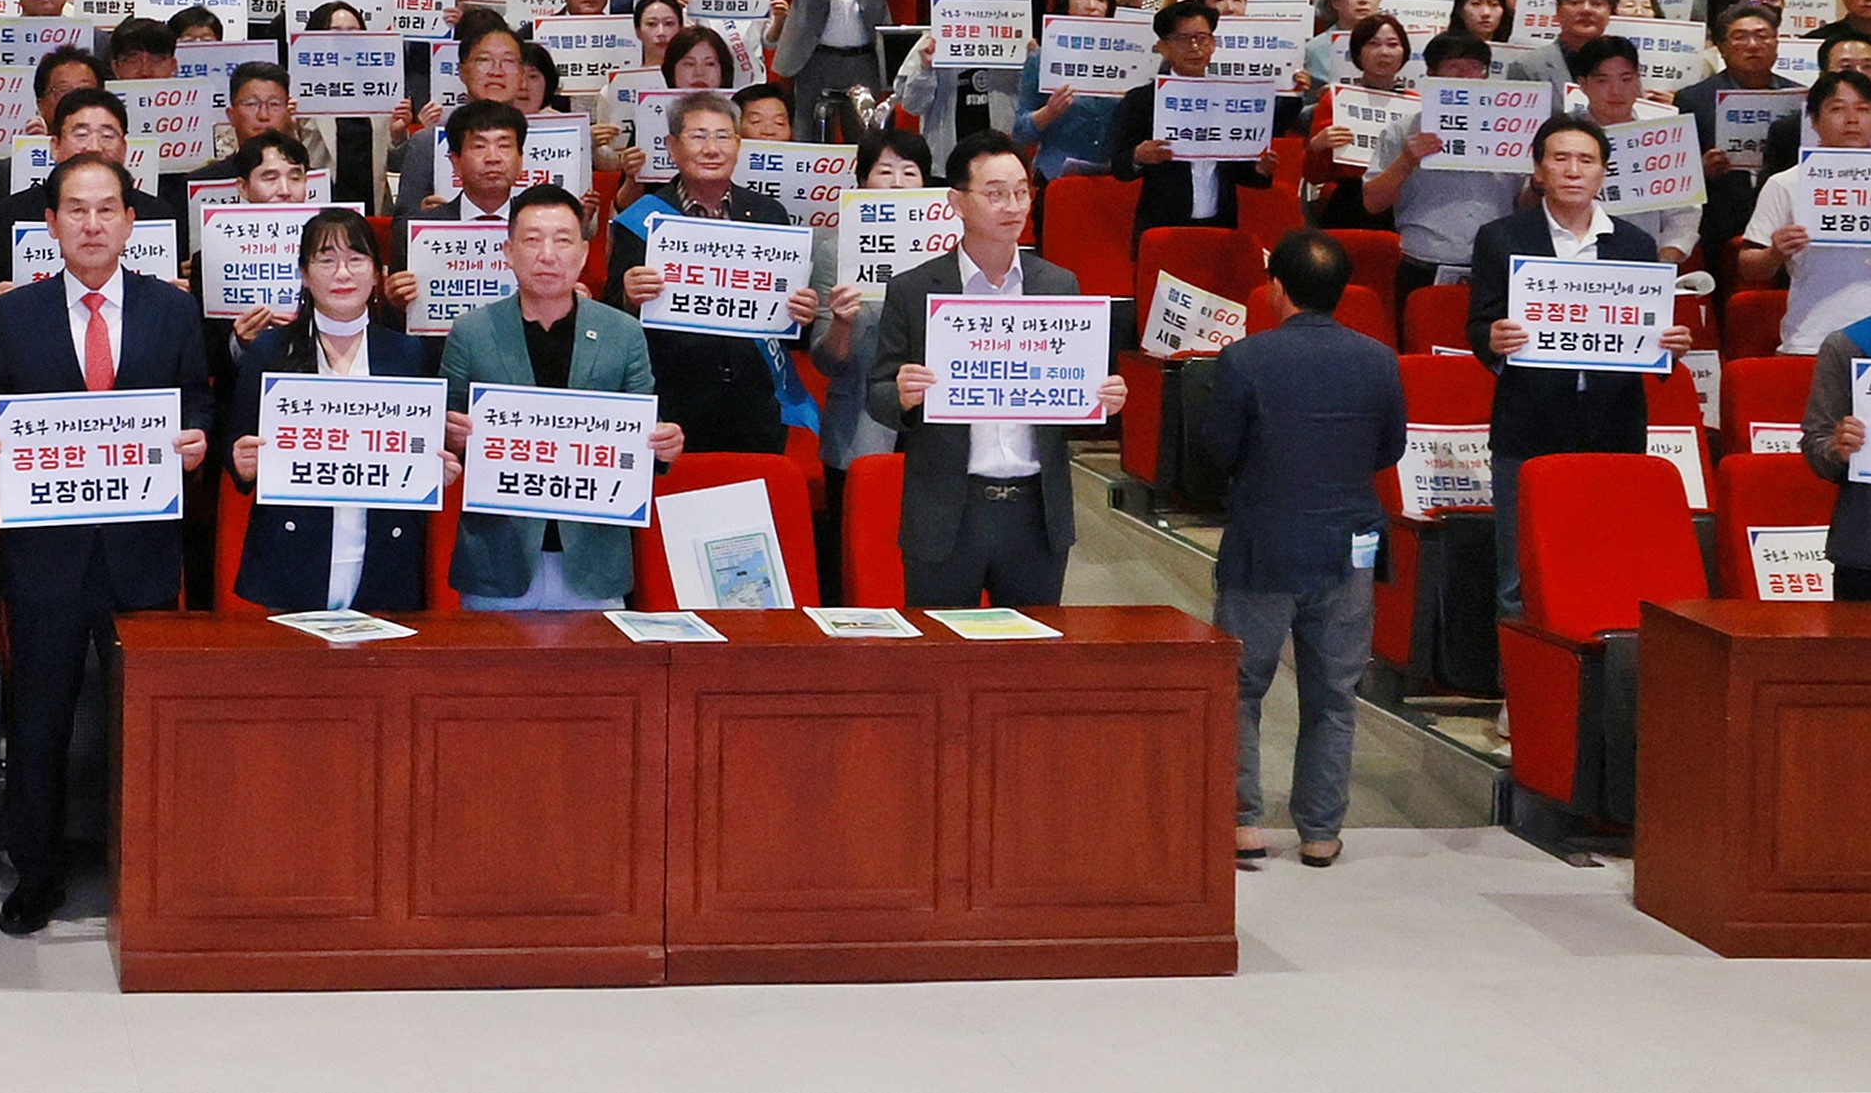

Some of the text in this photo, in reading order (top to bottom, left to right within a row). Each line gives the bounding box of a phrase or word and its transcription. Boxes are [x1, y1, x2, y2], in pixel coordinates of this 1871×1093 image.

[950, 44, 1003, 57] 보장하라
[299, 82, 397, 97] 고속철도 유치!
[749, 153, 783, 171] 철도
[860, 204, 896, 223] 철도
[859, 235, 896, 253] 진도
[664, 262, 788, 292] 철도기본권을
[223, 288, 272, 304] 진도가
[670, 293, 778, 321] 보장하라 !
[1524, 302, 1655, 326] 공정한 기회를
[1537, 332, 1644, 354] 보장하라 !
[276, 398, 431, 418] 국토부 가이드라인에 의거
[10, 415, 166, 437] 국토부 가이드라인에 의거
[276, 427, 425, 453] 공정한 기회를
[12, 443, 162, 471] 공정한 기회를
[483, 437, 635, 469] 공정한 기회를
[290, 462, 413, 488] 보장하라 !
[30, 476, 152, 505] 보장하라 !
[497, 471, 621, 503] 보장하라 !
[1769, 574, 1823, 593] 공정한
